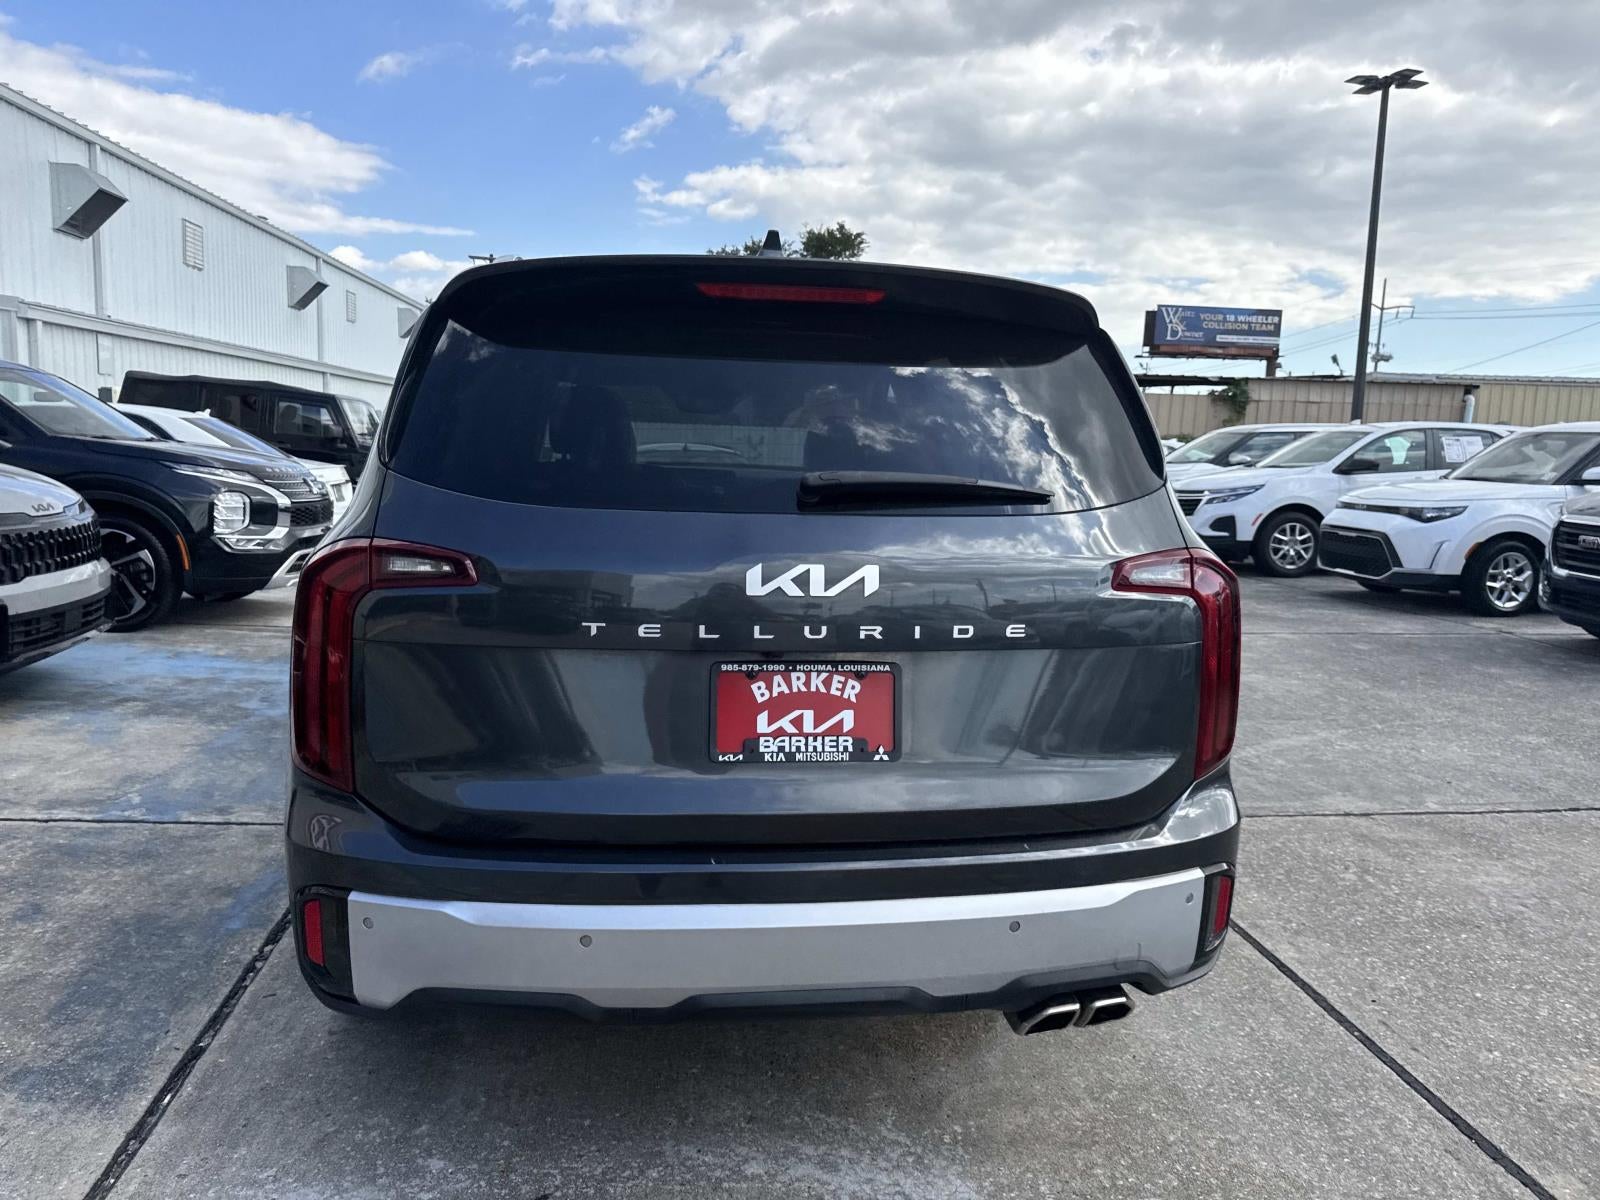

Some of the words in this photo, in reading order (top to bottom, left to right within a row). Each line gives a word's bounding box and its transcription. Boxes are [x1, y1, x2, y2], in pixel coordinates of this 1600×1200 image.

[1200, 313, 1224, 321] YOUR
[1226, 314, 1235, 322] 18
[1237, 315, 1279, 324] WHEELER
[1203, 321, 1248, 330] COLLISION
[1251, 323, 1275, 331] TEAM
[746, 563, 880, 597] KIA
[581, 622, 1027, 639] TELLURIDE
[720, 664, 785, 672] 985-879-1990
[838, 664, 891, 672] LOUISIANA
[750, 671, 862, 704] BARKER
[756, 709, 855, 733] KIA
[764, 752, 786, 762] KIA
[795, 752, 850, 762] MITSUBISHI
